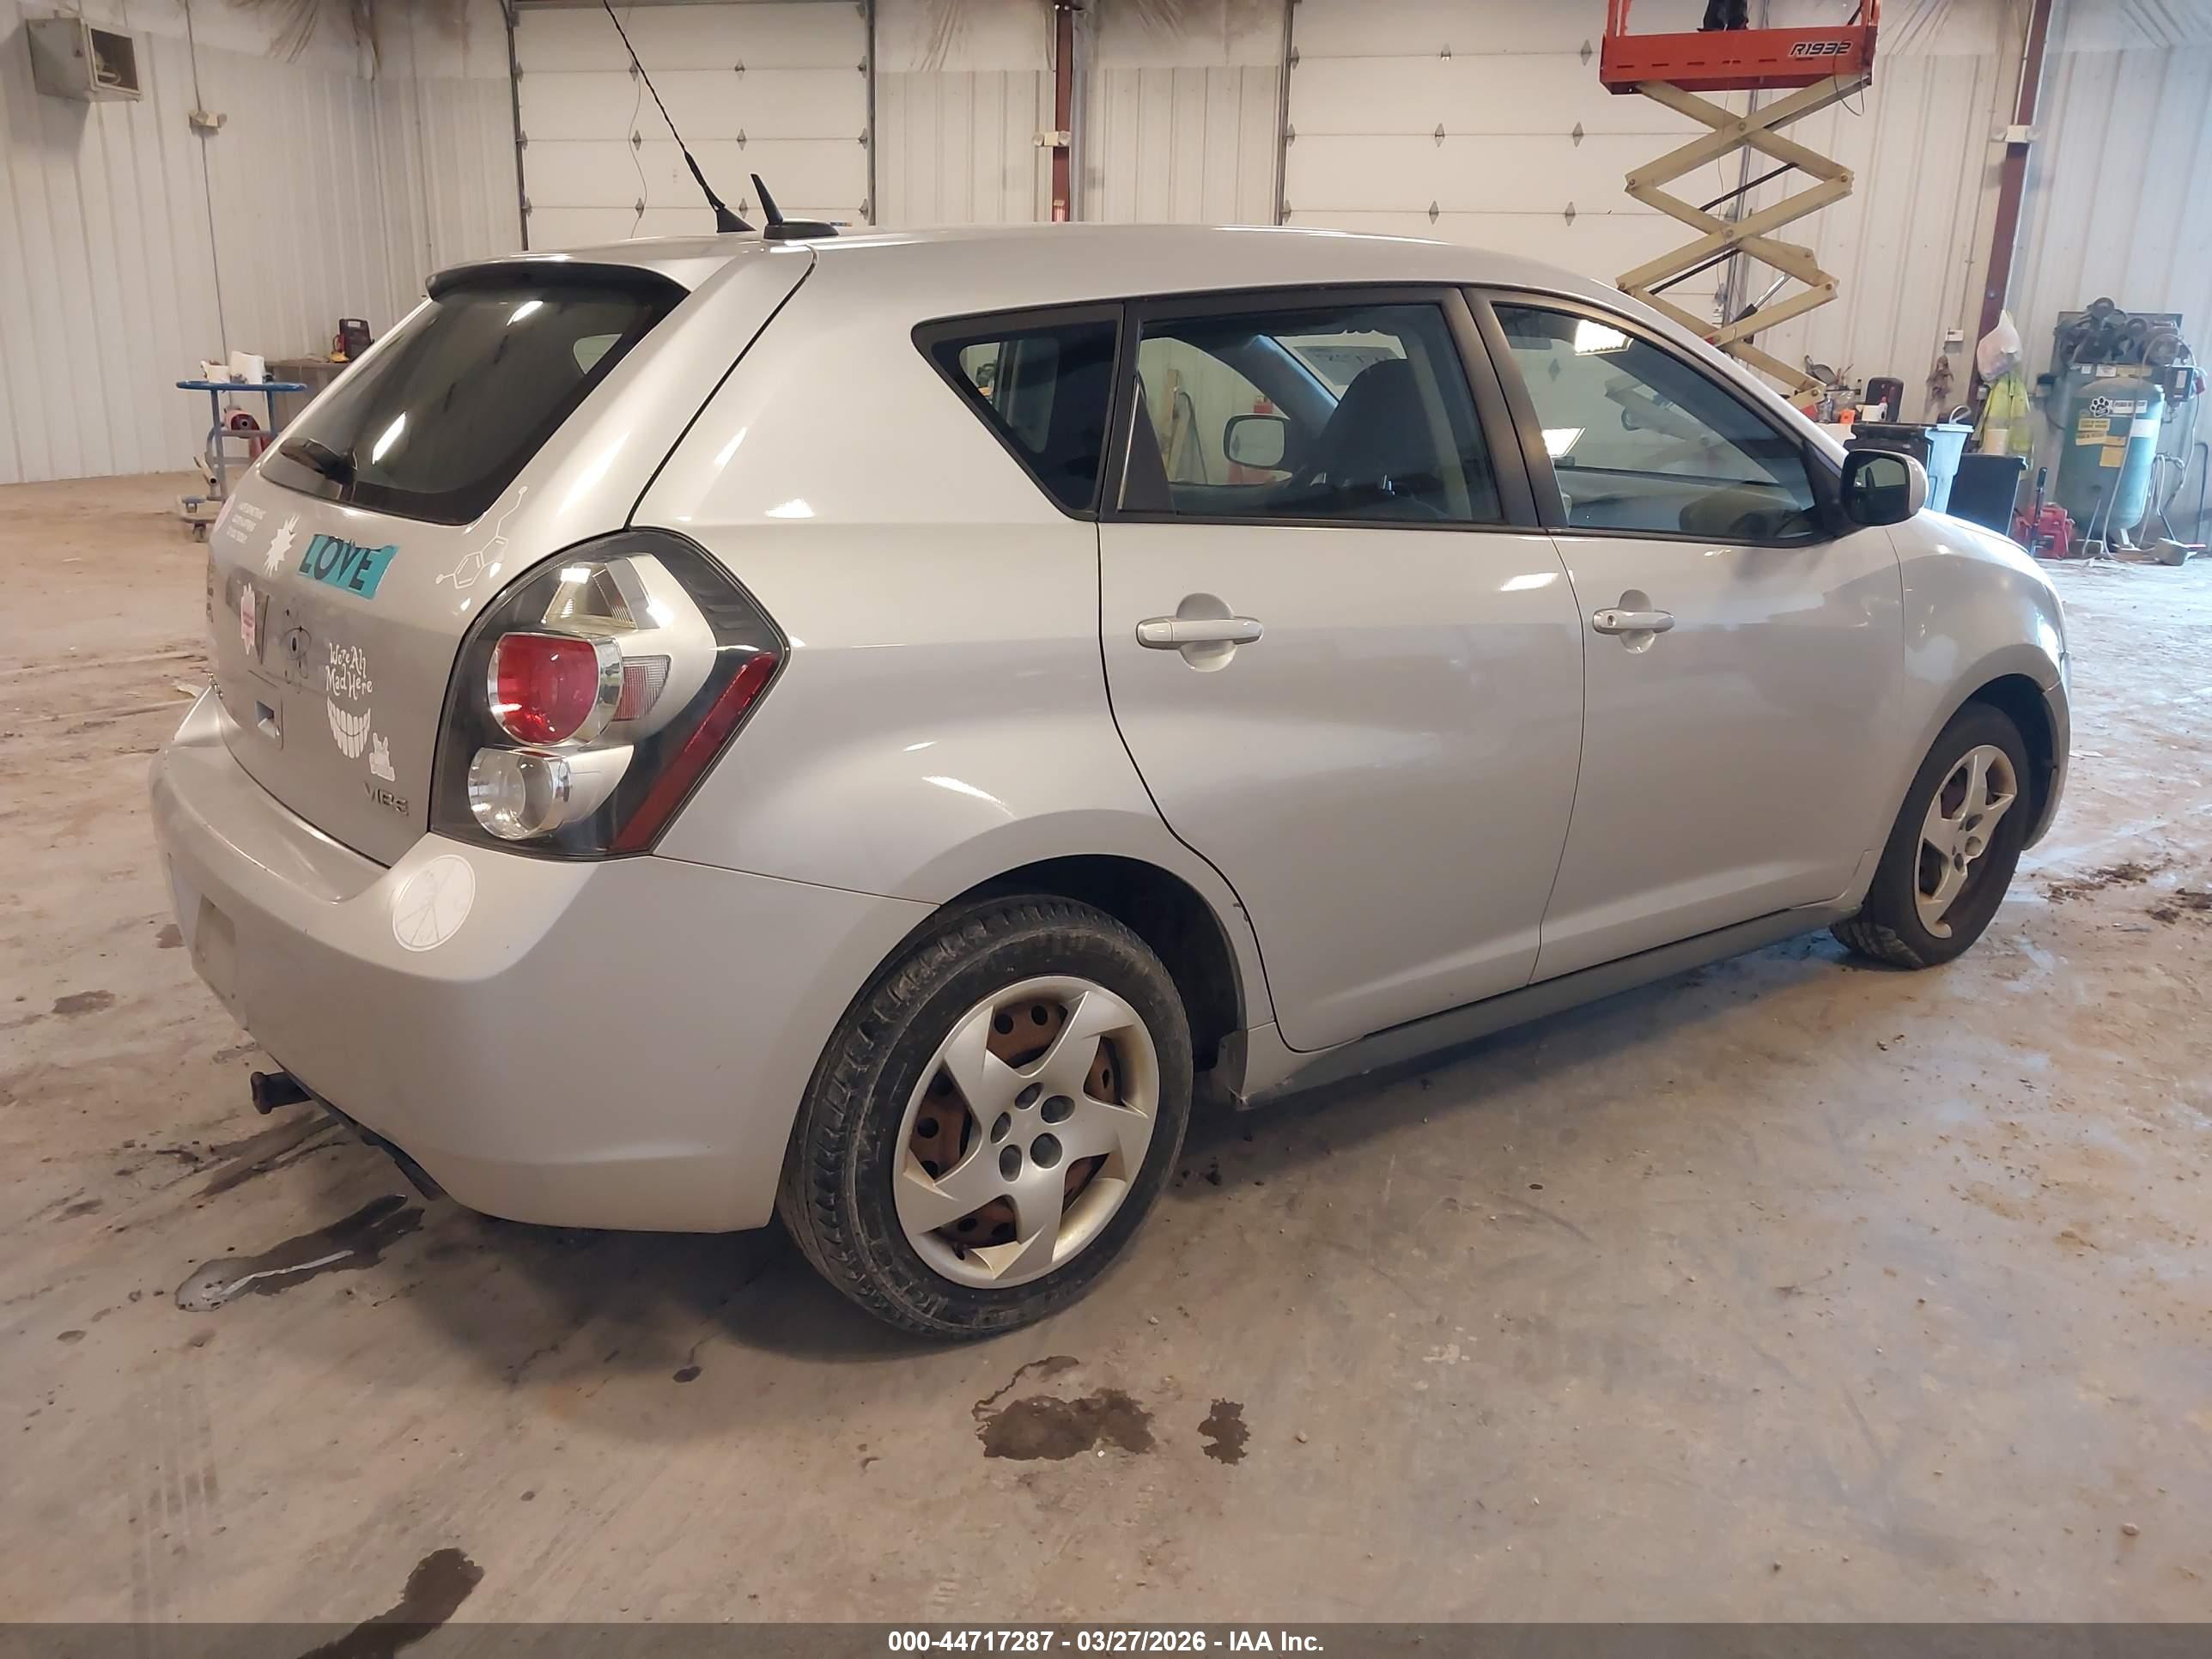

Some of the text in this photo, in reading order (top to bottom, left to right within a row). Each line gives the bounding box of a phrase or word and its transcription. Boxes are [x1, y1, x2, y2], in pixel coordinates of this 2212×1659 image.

[1790, 41, 1852, 57] R1932
[299, 533, 381, 591] LOVE
[349, 646, 367, 678] All
[325, 663, 374, 701] Mad Here
